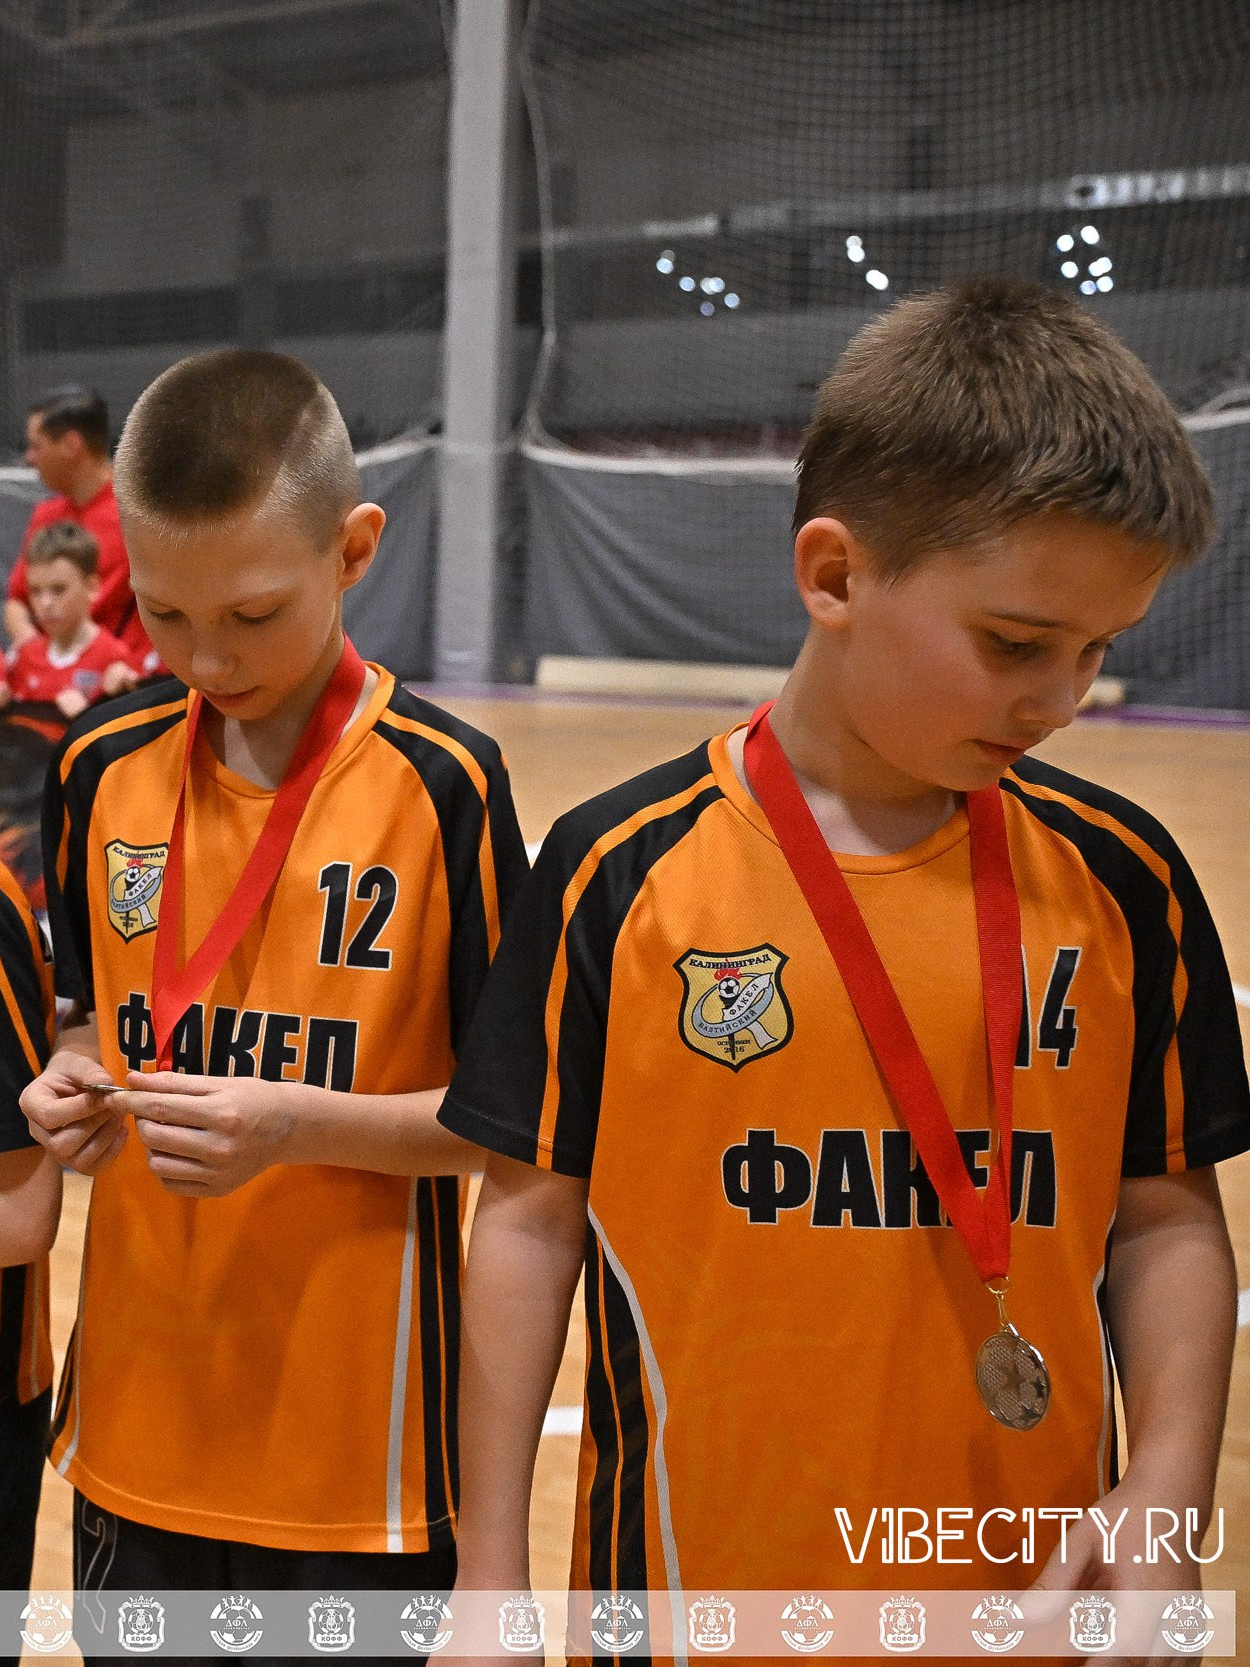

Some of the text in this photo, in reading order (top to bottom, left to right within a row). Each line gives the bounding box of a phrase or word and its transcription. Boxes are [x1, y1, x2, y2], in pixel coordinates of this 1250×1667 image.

[318, 861, 398, 971] 12
[689, 953, 772, 970] КАЛИНИНГРАД
[729, 982, 760, 1016] ФАКЕЛ
[723, 1046, 745, 1054] 216
